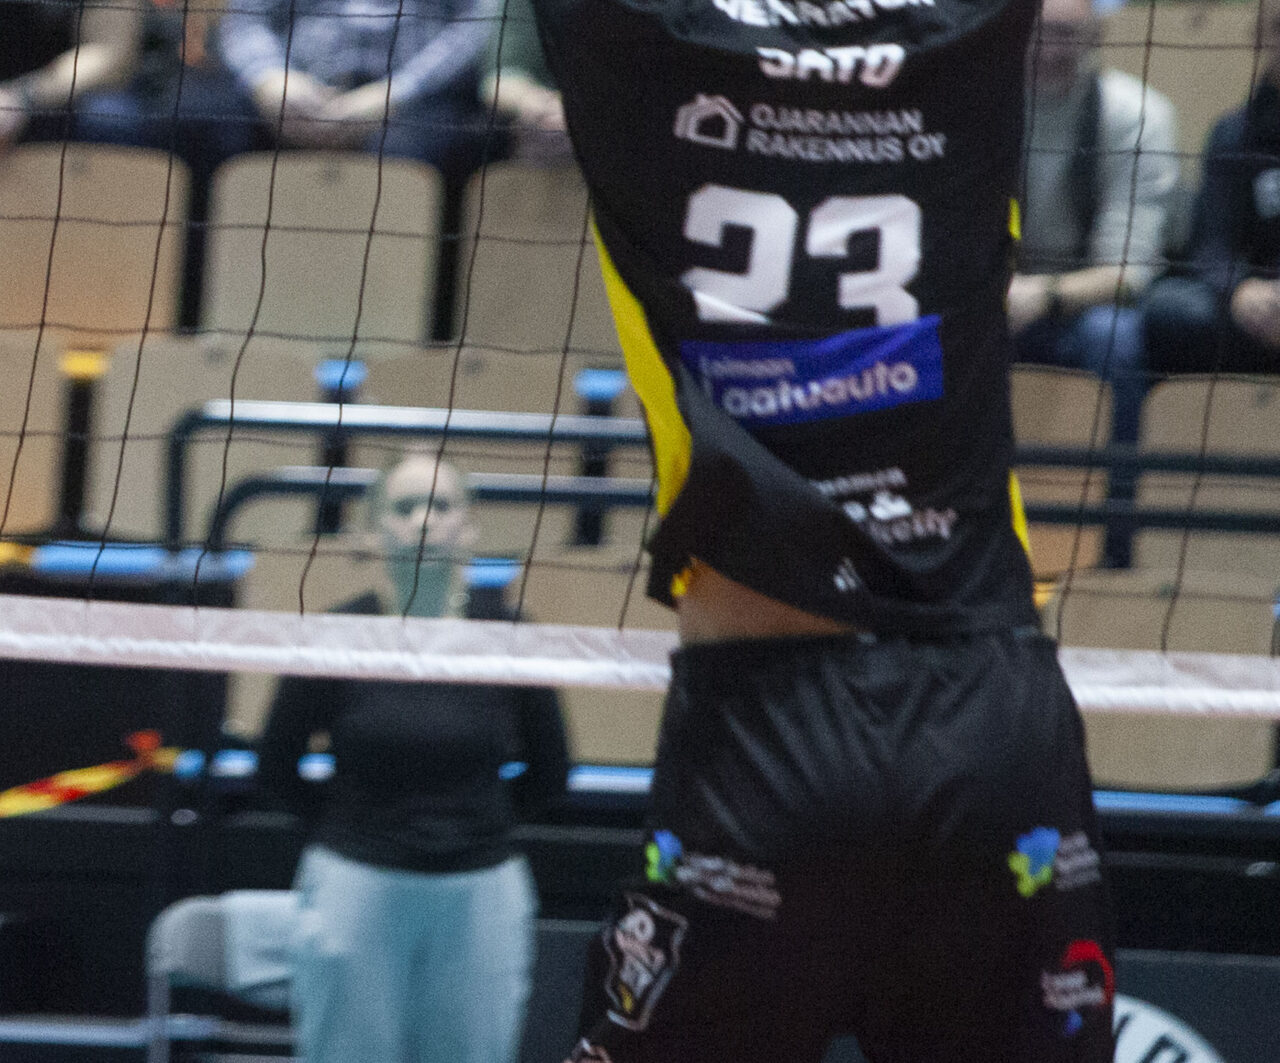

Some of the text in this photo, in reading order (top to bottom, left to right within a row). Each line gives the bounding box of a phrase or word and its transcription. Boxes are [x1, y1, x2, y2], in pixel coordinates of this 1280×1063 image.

[749, 102, 924, 135] OJARANNAN
[745, 128, 947, 163] RAKENNUS OY
[680, 183, 923, 327] 23
